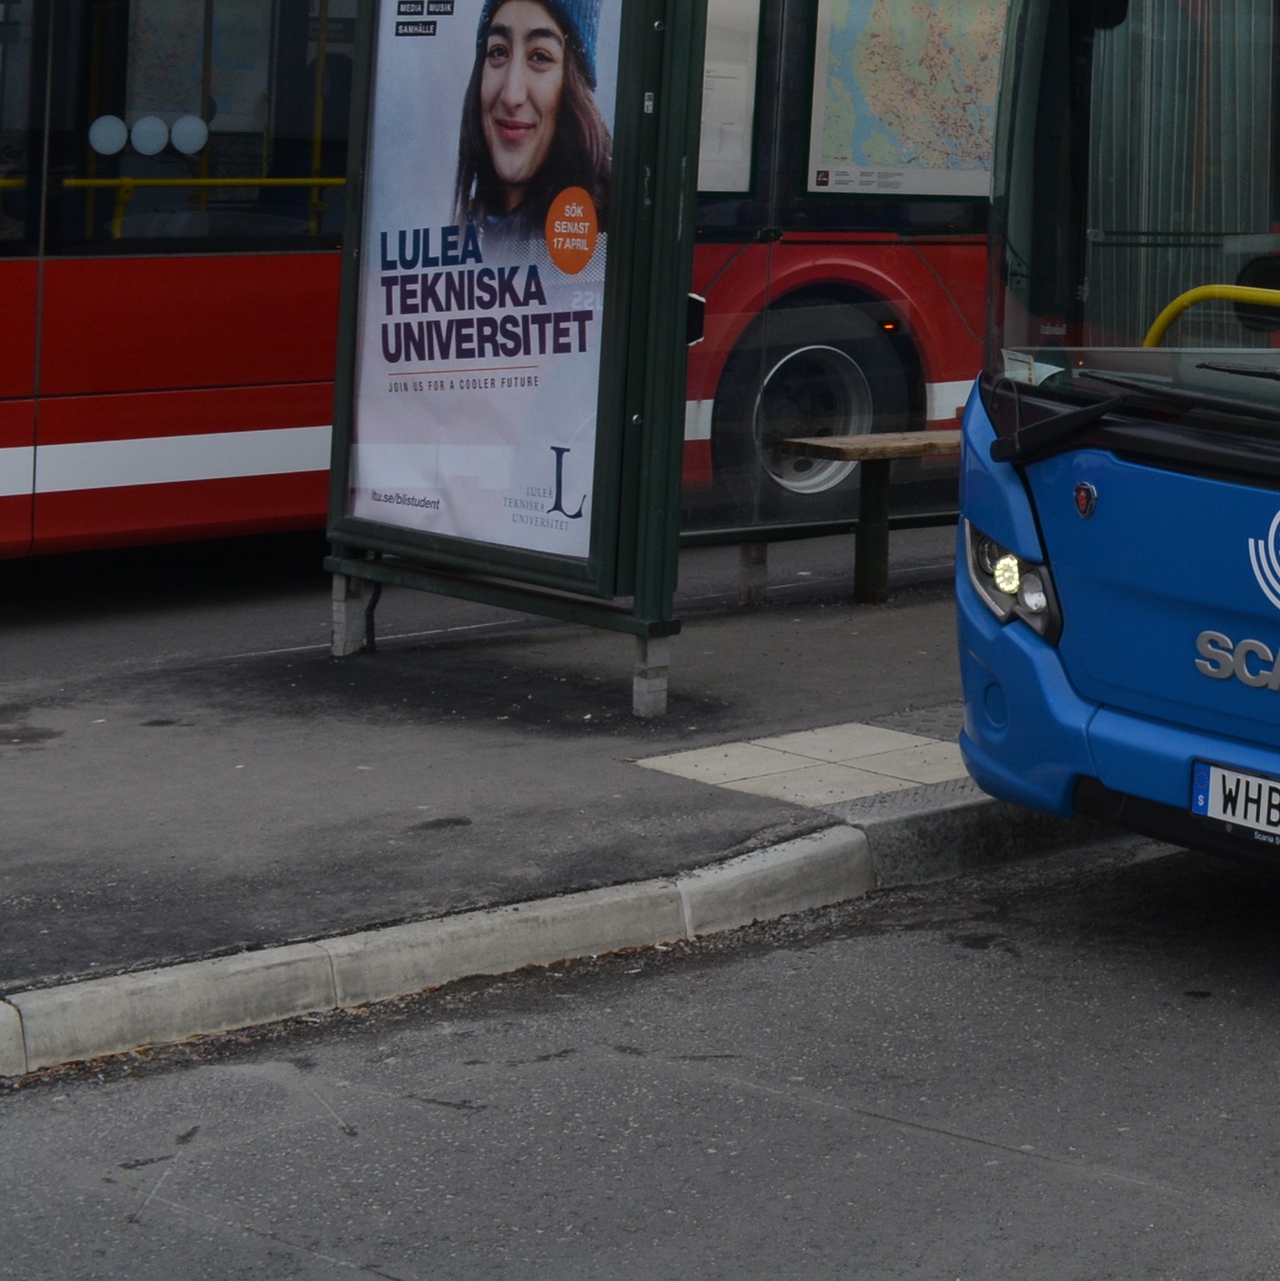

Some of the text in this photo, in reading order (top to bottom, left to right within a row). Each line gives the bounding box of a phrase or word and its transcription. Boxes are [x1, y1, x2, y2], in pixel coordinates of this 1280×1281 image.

[399, 3, 453, 12] MEDIA MUSIK
[397, 22, 434, 34] SAMHÄLLE
[564, 204, 584, 217] SÖK
[553, 221, 591, 235] SENAST
[380, 213, 484, 271] LULEÅ
[552, 237, 590, 251] 17 APRIL
[380, 264, 548, 316] TEKNISKA
[381, 309, 594, 364] UNIVERSITET
[388, 375, 540, 393] JOIN US FOR A COOLER FUTURE
[546, 445, 587, 520] L
[371, 489, 441, 510] ltu.se/blistudent
[526, 485, 554, 499] LULEÅ
[502, 496, 546, 513] TEKNISKA
[511, 513, 571, 531] UNIVERSITET
[1197, 794, 1205, 807] S
[1253, 830, 1275, 844] Scania
